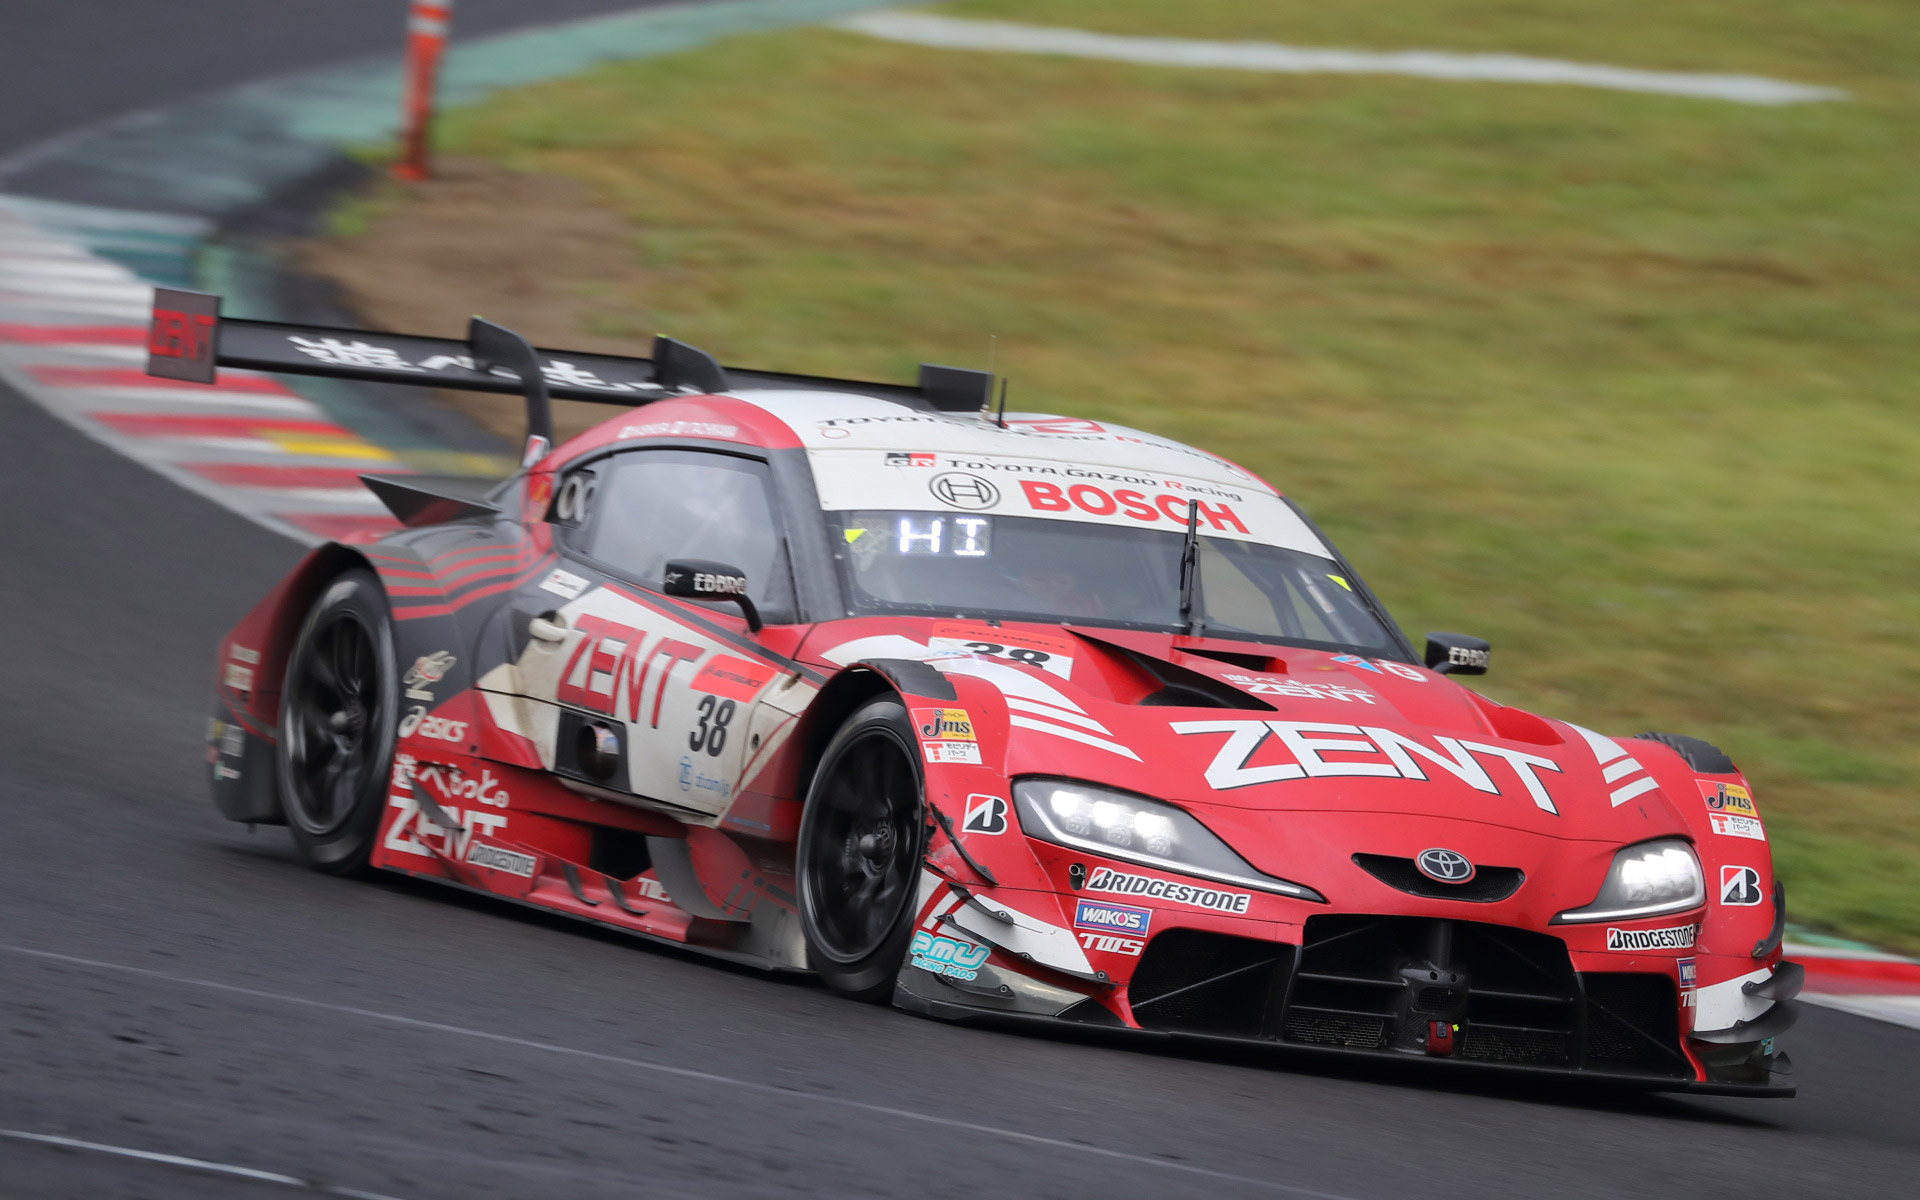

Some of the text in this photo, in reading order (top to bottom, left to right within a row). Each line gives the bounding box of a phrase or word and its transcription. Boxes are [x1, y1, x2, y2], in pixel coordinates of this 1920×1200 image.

[945, 460, 1243, 502] TOYOTA GAZOO Racing
[1018, 479, 1251, 534] BOSCH
[899, 517, 988, 556] HI
[557, 613, 706, 730] ZENT
[1233, 681, 1377, 704] ZENT
[689, 694, 736, 757] 38
[1168, 720, 1563, 817] ZENT
[1088, 868, 1249, 913] BRIDGESTONE
[1078, 932, 1145, 956] TWS
[1608, 926, 1694, 949] BRIDGESTONE
[911, 956, 978, 981] RACING PADS
